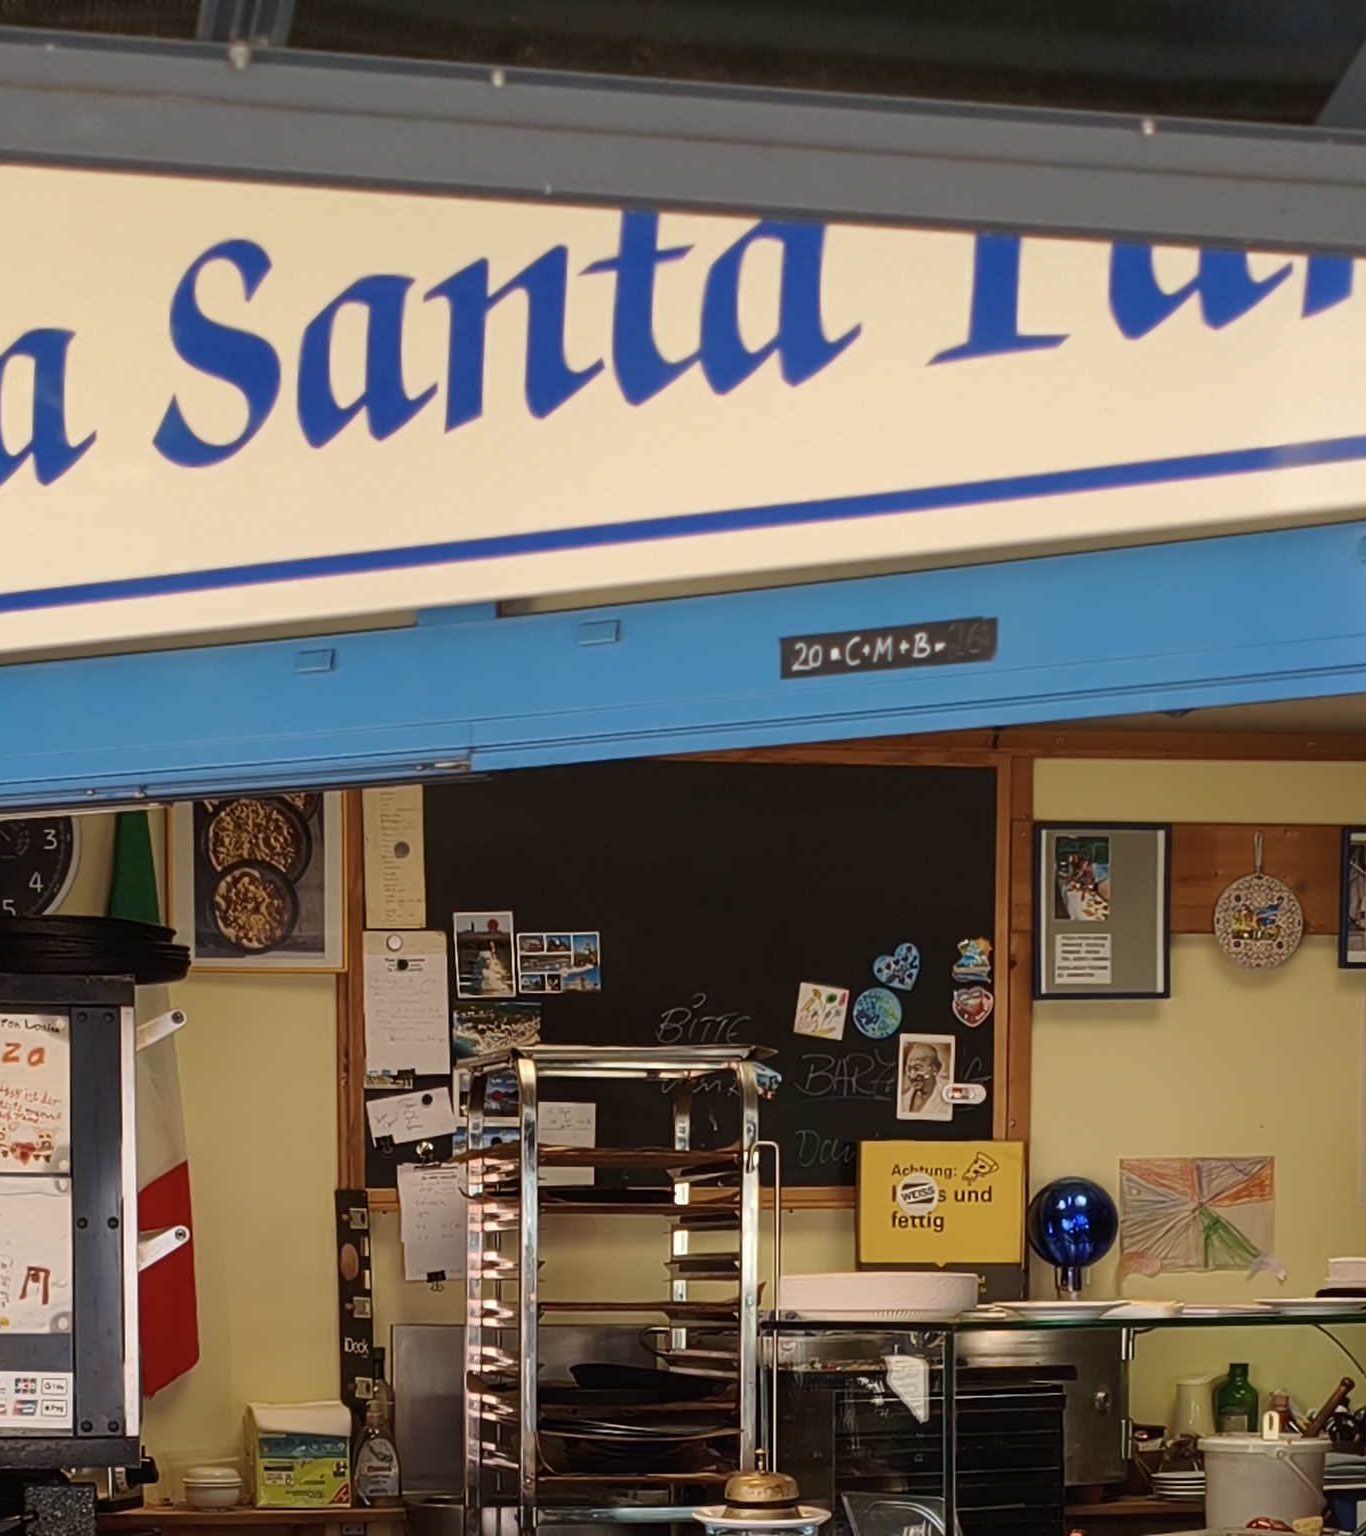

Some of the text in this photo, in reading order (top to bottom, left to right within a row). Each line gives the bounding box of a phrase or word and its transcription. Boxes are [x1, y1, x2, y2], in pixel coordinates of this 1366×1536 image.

[151, 208, 865, 469] Santa
[791, 642, 823, 672] 20
[43, 829, 57, 850] 3
[29, 871, 44, 893] 4
[891, 1164, 957, 1179] Achtung:
[900, 1186, 936, 1201] WEISS
[954, 1185, 993, 1203] und
[891, 1210, 945, 1233] fettig
